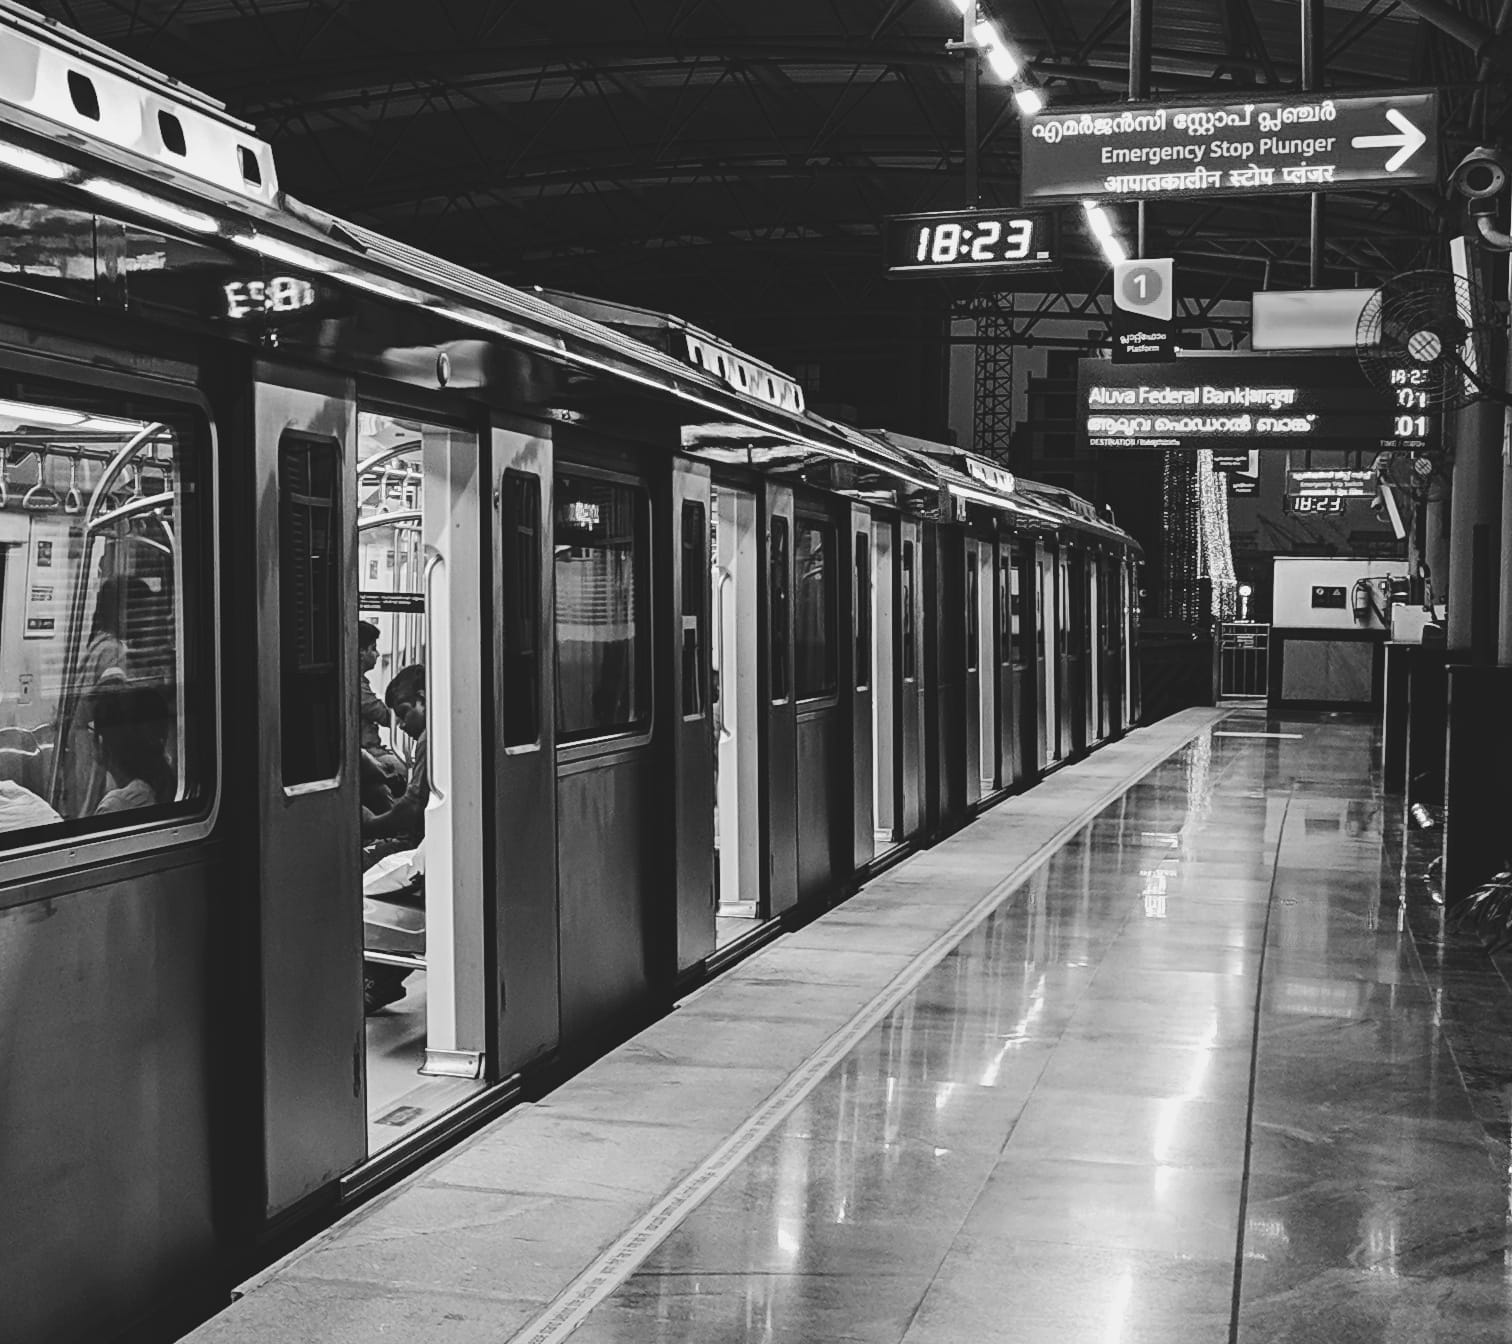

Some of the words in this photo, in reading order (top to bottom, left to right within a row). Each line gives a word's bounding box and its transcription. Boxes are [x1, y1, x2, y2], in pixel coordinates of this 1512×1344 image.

[1101, 142, 1206, 164] Emergency
[1210, 140, 1254, 160] Stop
[1259, 137, 1336, 156] Plunger
[1104, 166, 1222, 193] आपातकालीन
[1229, 164, 1275, 187] स्टोप
[1282, 162, 1336, 183] प्लंजर
[916, 219, 1033, 263] 18:23
[1133, 274, 1147, 298] 1
[1089, 387, 1135, 404] Aluva
[1139, 387, 1199, 404] Federal
